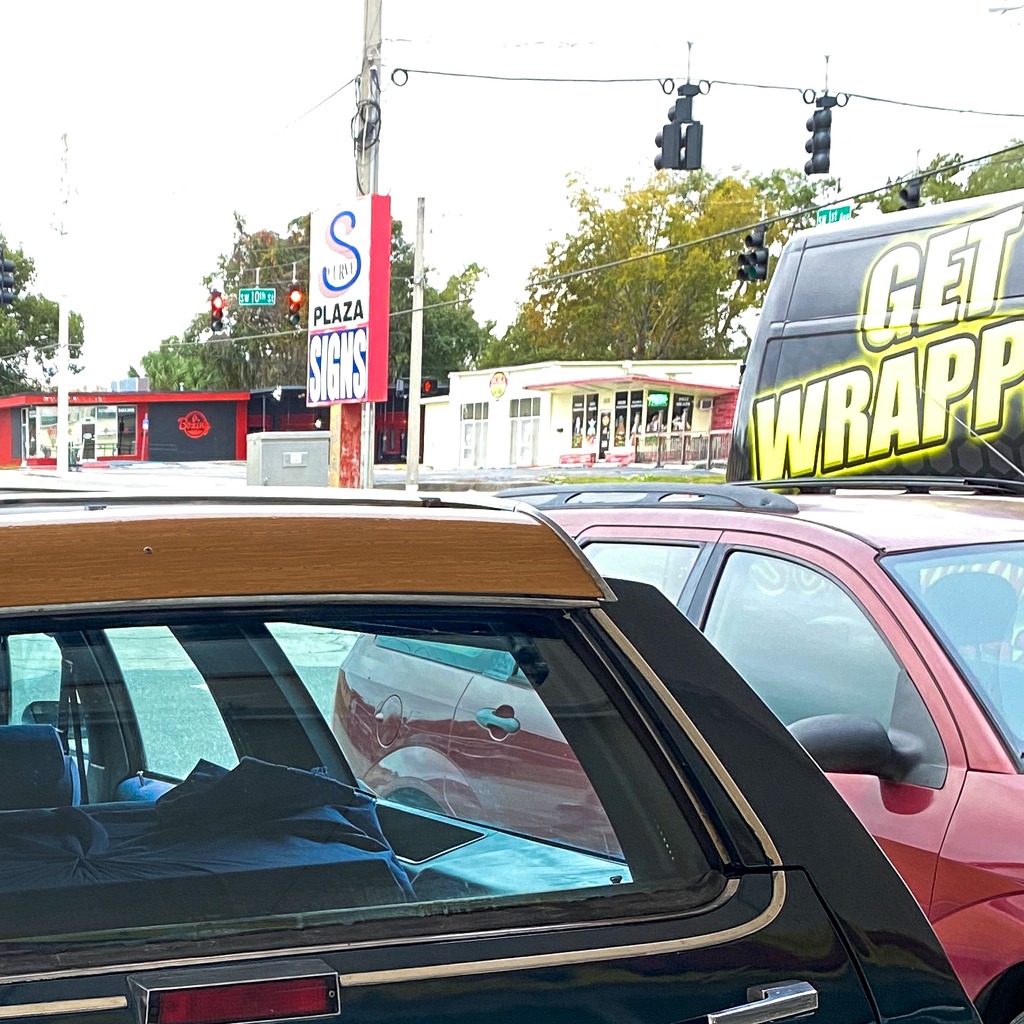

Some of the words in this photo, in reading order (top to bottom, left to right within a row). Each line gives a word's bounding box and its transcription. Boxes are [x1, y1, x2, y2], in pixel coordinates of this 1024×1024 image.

[240, 293, 249, 303] SW
[251, 290, 266, 303] 10th
[862, 204, 1024, 351] GET
[314, 299, 364, 327] PLAZA
[309, 328, 367, 403] SIGNS
